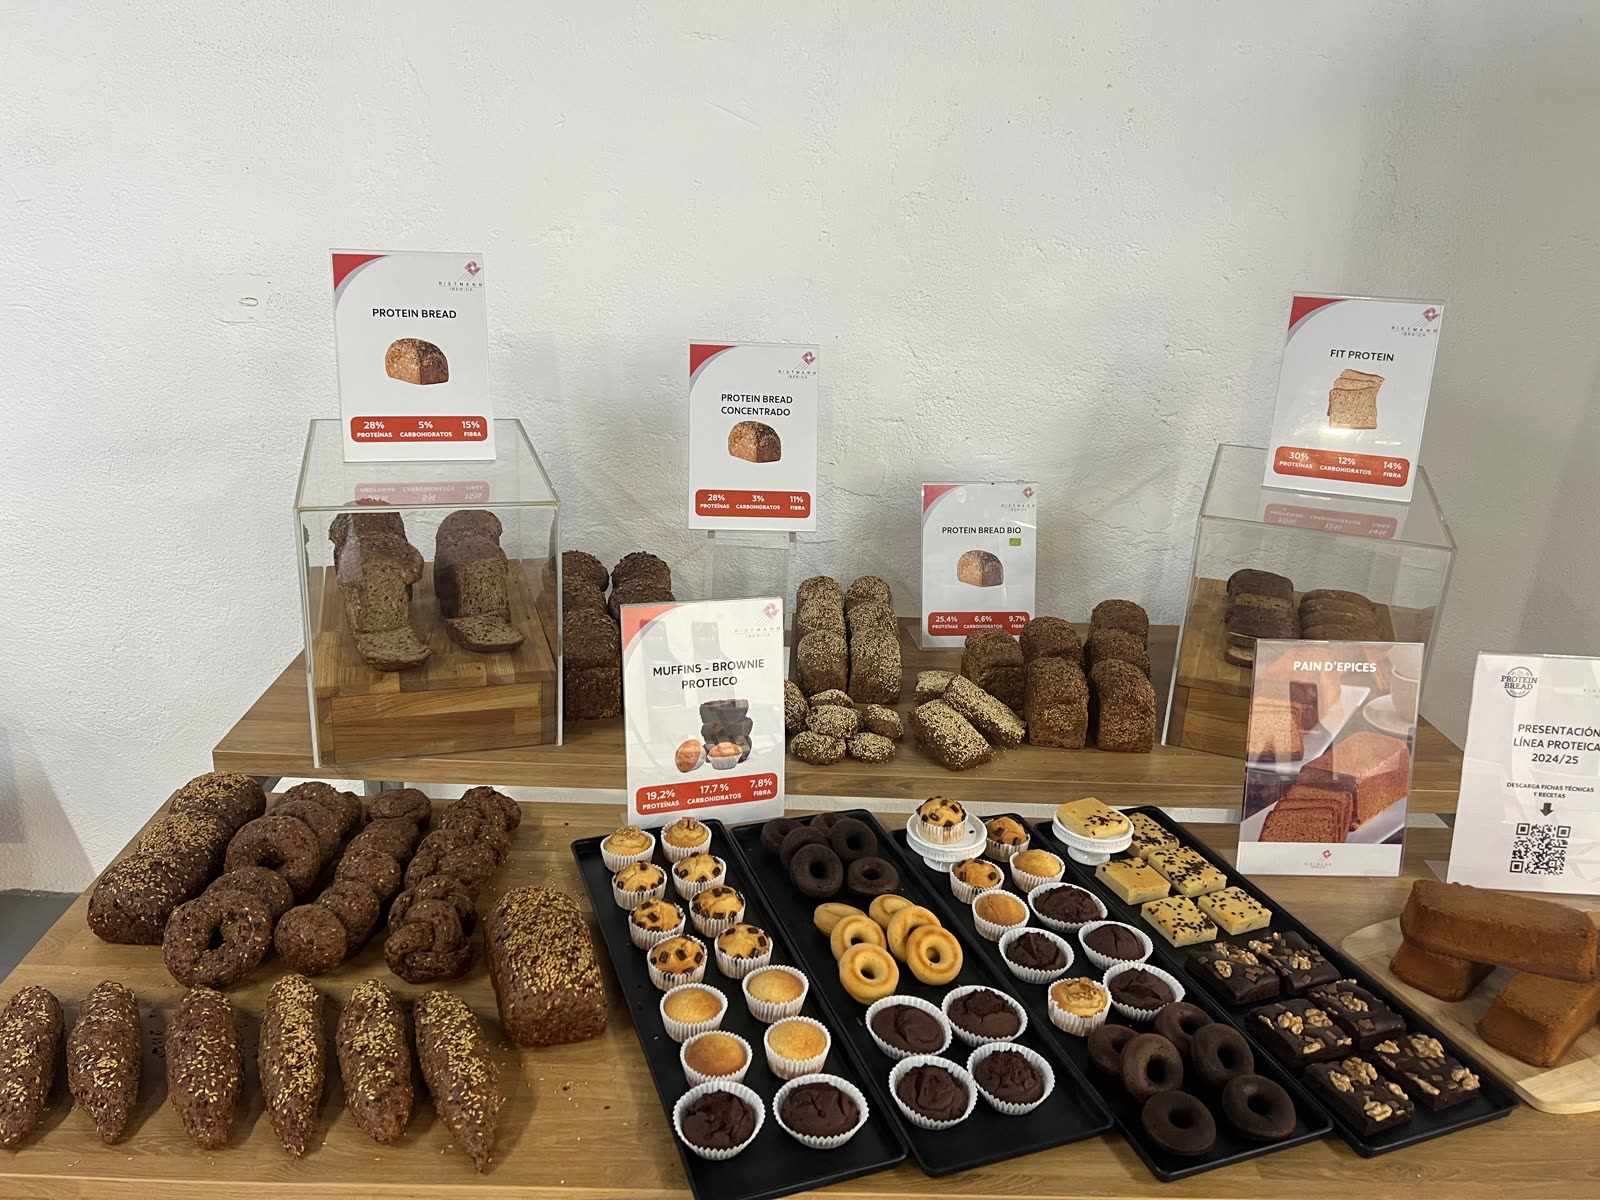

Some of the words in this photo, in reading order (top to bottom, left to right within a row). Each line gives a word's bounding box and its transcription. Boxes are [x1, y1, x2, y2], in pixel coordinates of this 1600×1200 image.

[372, 308, 419, 318] PROTEIN
[421, 310, 457, 319] BREAD
[1330, 349, 1346, 358] FIT
[1347, 350, 1394, 362] PROTEIN
[721, 394, 761, 403] PROTEIN
[762, 396, 793, 404] BREAD
[721, 406, 791, 416] CONCENTRADO
[363, 421, 385, 429] 28%
[418, 421, 434, 429] 5%
[461, 421, 481, 429] 15%
[463, 430, 482, 438] FIBRA
[1288, 452, 1310, 461] 30%
[1338, 456, 1357, 465] 12%
[1383, 461, 1403, 471] 14%
[1319, 465, 1373, 476] CARBOHIDRATOS
[1382, 471, 1402, 479] FIBRA
[707, 493, 726, 501] 28%
[751, 494, 765, 502] 3%
[789, 495, 804, 503] 11%
[941, 526, 977, 534] PROTEIN
[978, 526, 1006, 534] BREAD
[653, 663, 702, 677] MUFFINS
[712, 659, 765, 672] BROWNIE
[1293, 661, 1322, 672] PAIN
[1324, 661, 1377, 672] D'EPICES
[681, 677, 738, 690] PROTEICO
[1501, 675, 1538, 684] PROTEIN
[1504, 682, 1533, 690] BREAD
[1518, 724, 1600, 738] PRESENTACIÓN
[1513, 736, 1544, 748] LÍNEA
[1547, 740, 1600, 752] PROTEICA
[1531, 753, 1579, 765] 2024/25
[646, 789, 676, 801] 19,2%
[699, 784, 718, 794] 17,7
[749, 778, 773, 789] 7,8%
[1506, 782, 1540, 790] DESCARGA
[1565, 785, 1595, 793] TÉCNICAS
[642, 800, 680, 810] PROTEÍNAS
[687, 793, 742, 805] CARBOHIDRATOS
[753, 788, 772, 797] FIBRA
